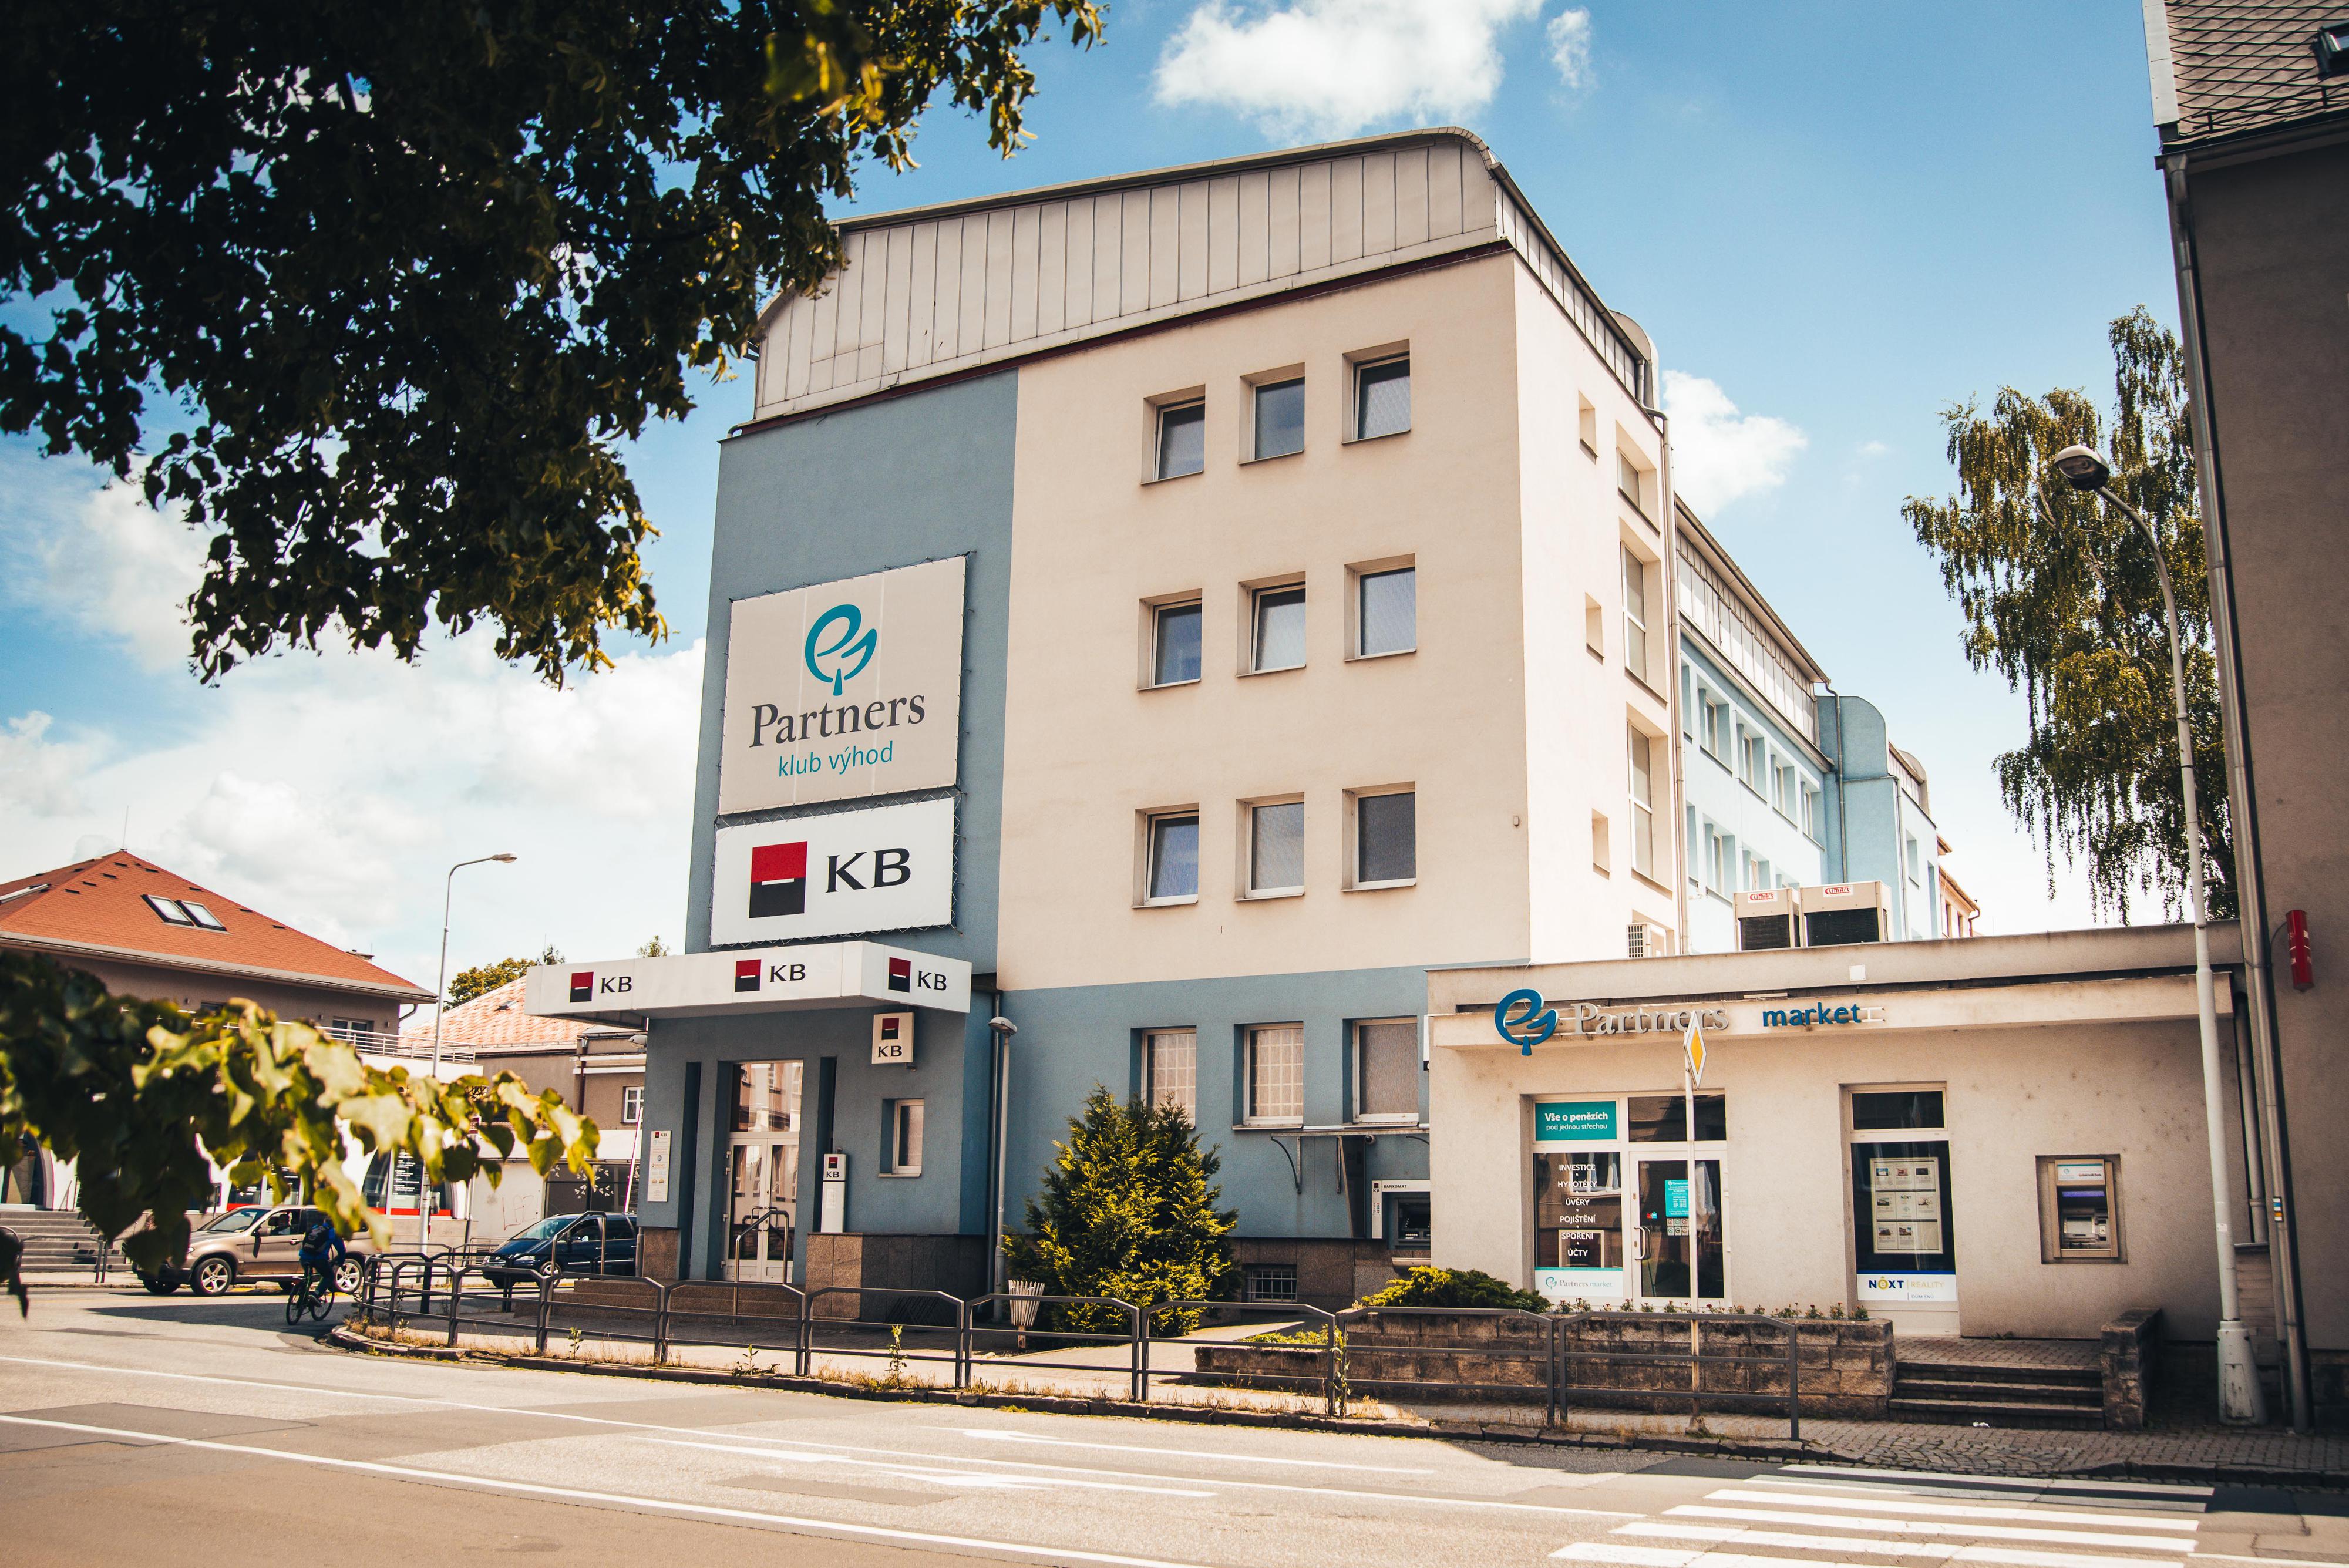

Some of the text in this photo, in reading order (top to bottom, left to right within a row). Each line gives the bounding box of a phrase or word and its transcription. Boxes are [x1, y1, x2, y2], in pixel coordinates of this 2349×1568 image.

[749, 695, 925, 748] Partners
[779, 740, 893, 777] klub výhod
[824, 847, 911, 894] KB
[769, 963, 806, 983] KB
[917, 970, 947, 991] KB
[600, 975, 632, 994] KB
[1570, 1001, 1862, 1035] Partners market
[877, 1045, 903, 1058] KB
[1544, 1113, 1560, 1122] Vše
[1570, 1111, 1608, 1123] penězích
[1557, 1179, 1598, 1187] HYOTÉKY
[1565, 1197, 1590, 1206] ÚVĚRY
[1560, 1214, 1596, 1224] POJIŠTĚNÍ
[1567, 1248, 1589, 1257] ÚČTY
